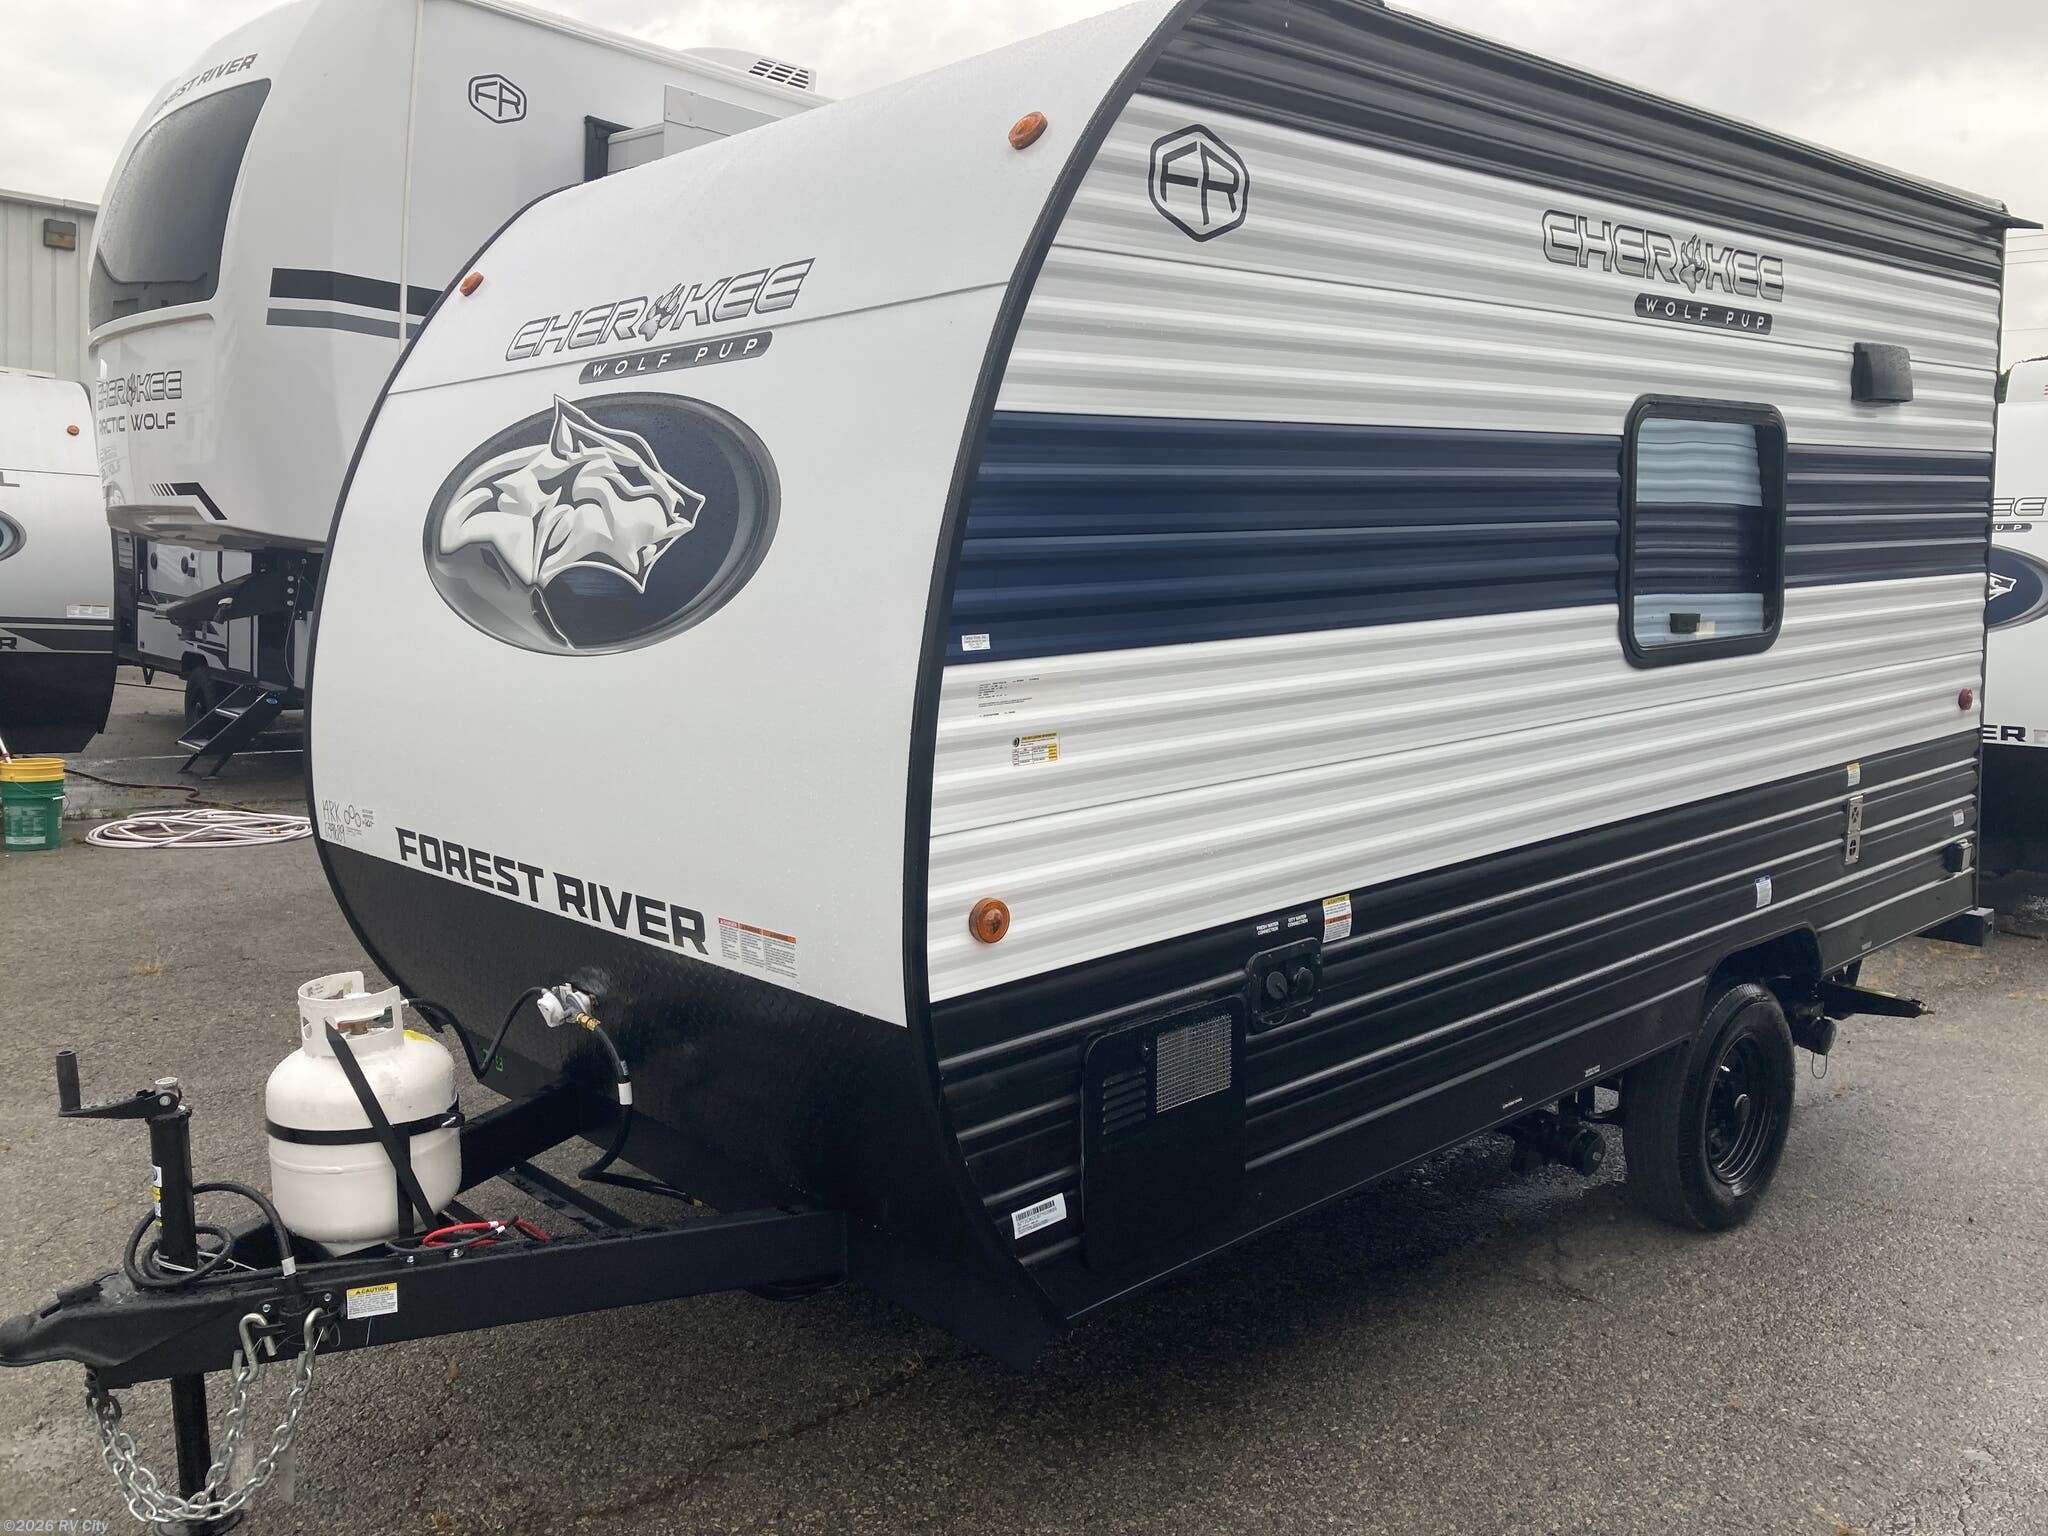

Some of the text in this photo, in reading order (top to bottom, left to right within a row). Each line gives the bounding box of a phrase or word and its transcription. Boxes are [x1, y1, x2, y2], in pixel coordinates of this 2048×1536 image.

[197, 53, 258, 86] RIVER
[475, 80, 521, 117] FR
[1160, 140, 1240, 226] FR
[1645, 297, 1766, 329] WOLF PUP
[591, 337, 760, 378] WOLF PUP
[130, 411, 176, 432] WOLF
[395, 827, 545, 903] FOREST
[554, 872, 709, 955] RIVER
[1257, 926, 1279, 936] CONNECTION
[361, 1286, 389, 1295] CAUTION
